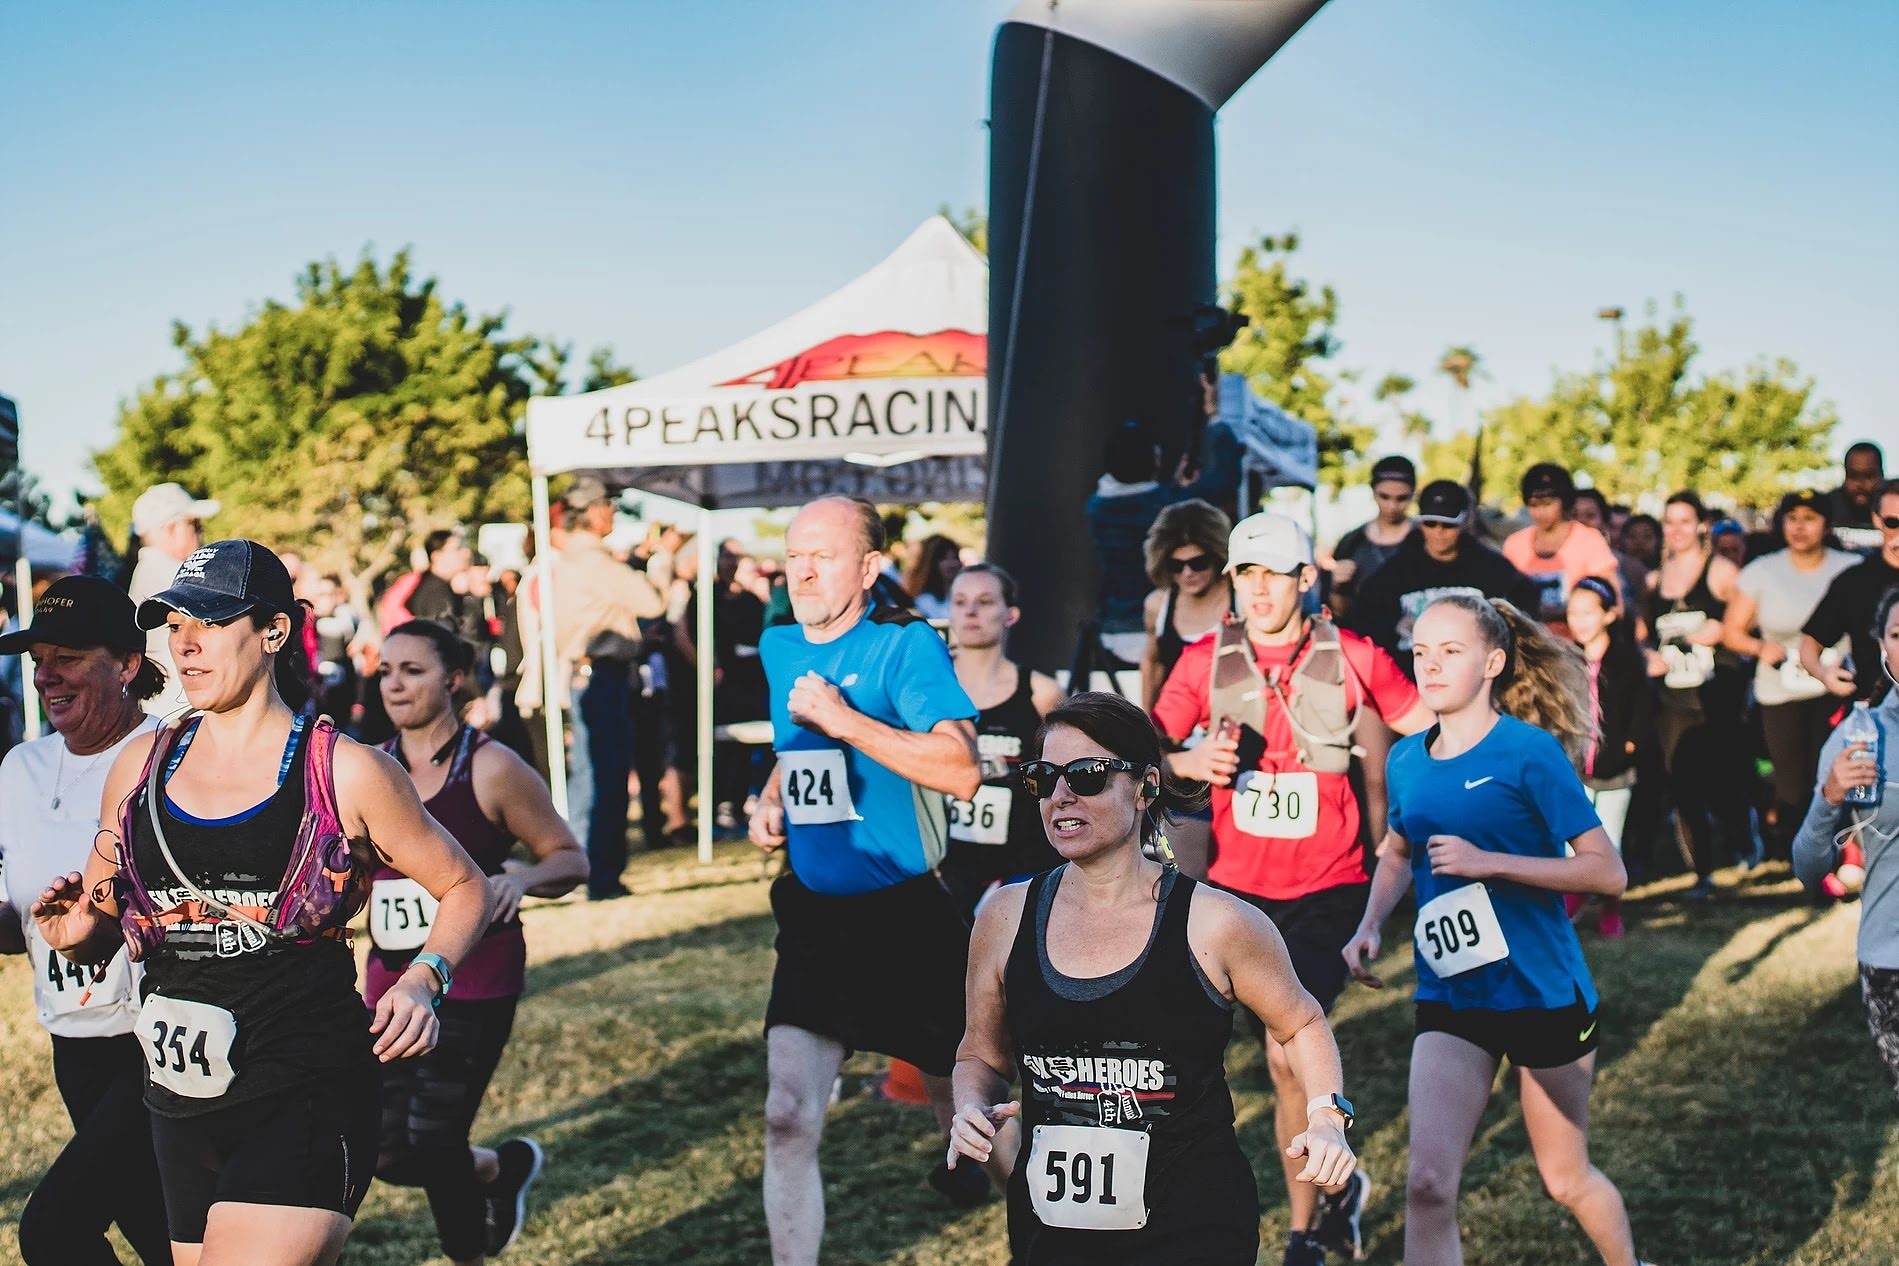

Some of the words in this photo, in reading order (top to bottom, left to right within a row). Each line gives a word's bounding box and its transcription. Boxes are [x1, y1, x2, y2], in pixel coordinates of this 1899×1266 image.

[585, 389, 987, 447] 4PEAKSRACIN
[788, 768, 833, 806] 424
[1247, 787, 1300, 820] 730
[381, 896, 429, 931] 751
[1425, 909, 1480, 960] 509
[152, 1020, 212, 1076] 354
[1076, 1057, 1165, 1091] HEROES
[1046, 1150, 1117, 1205] 591
